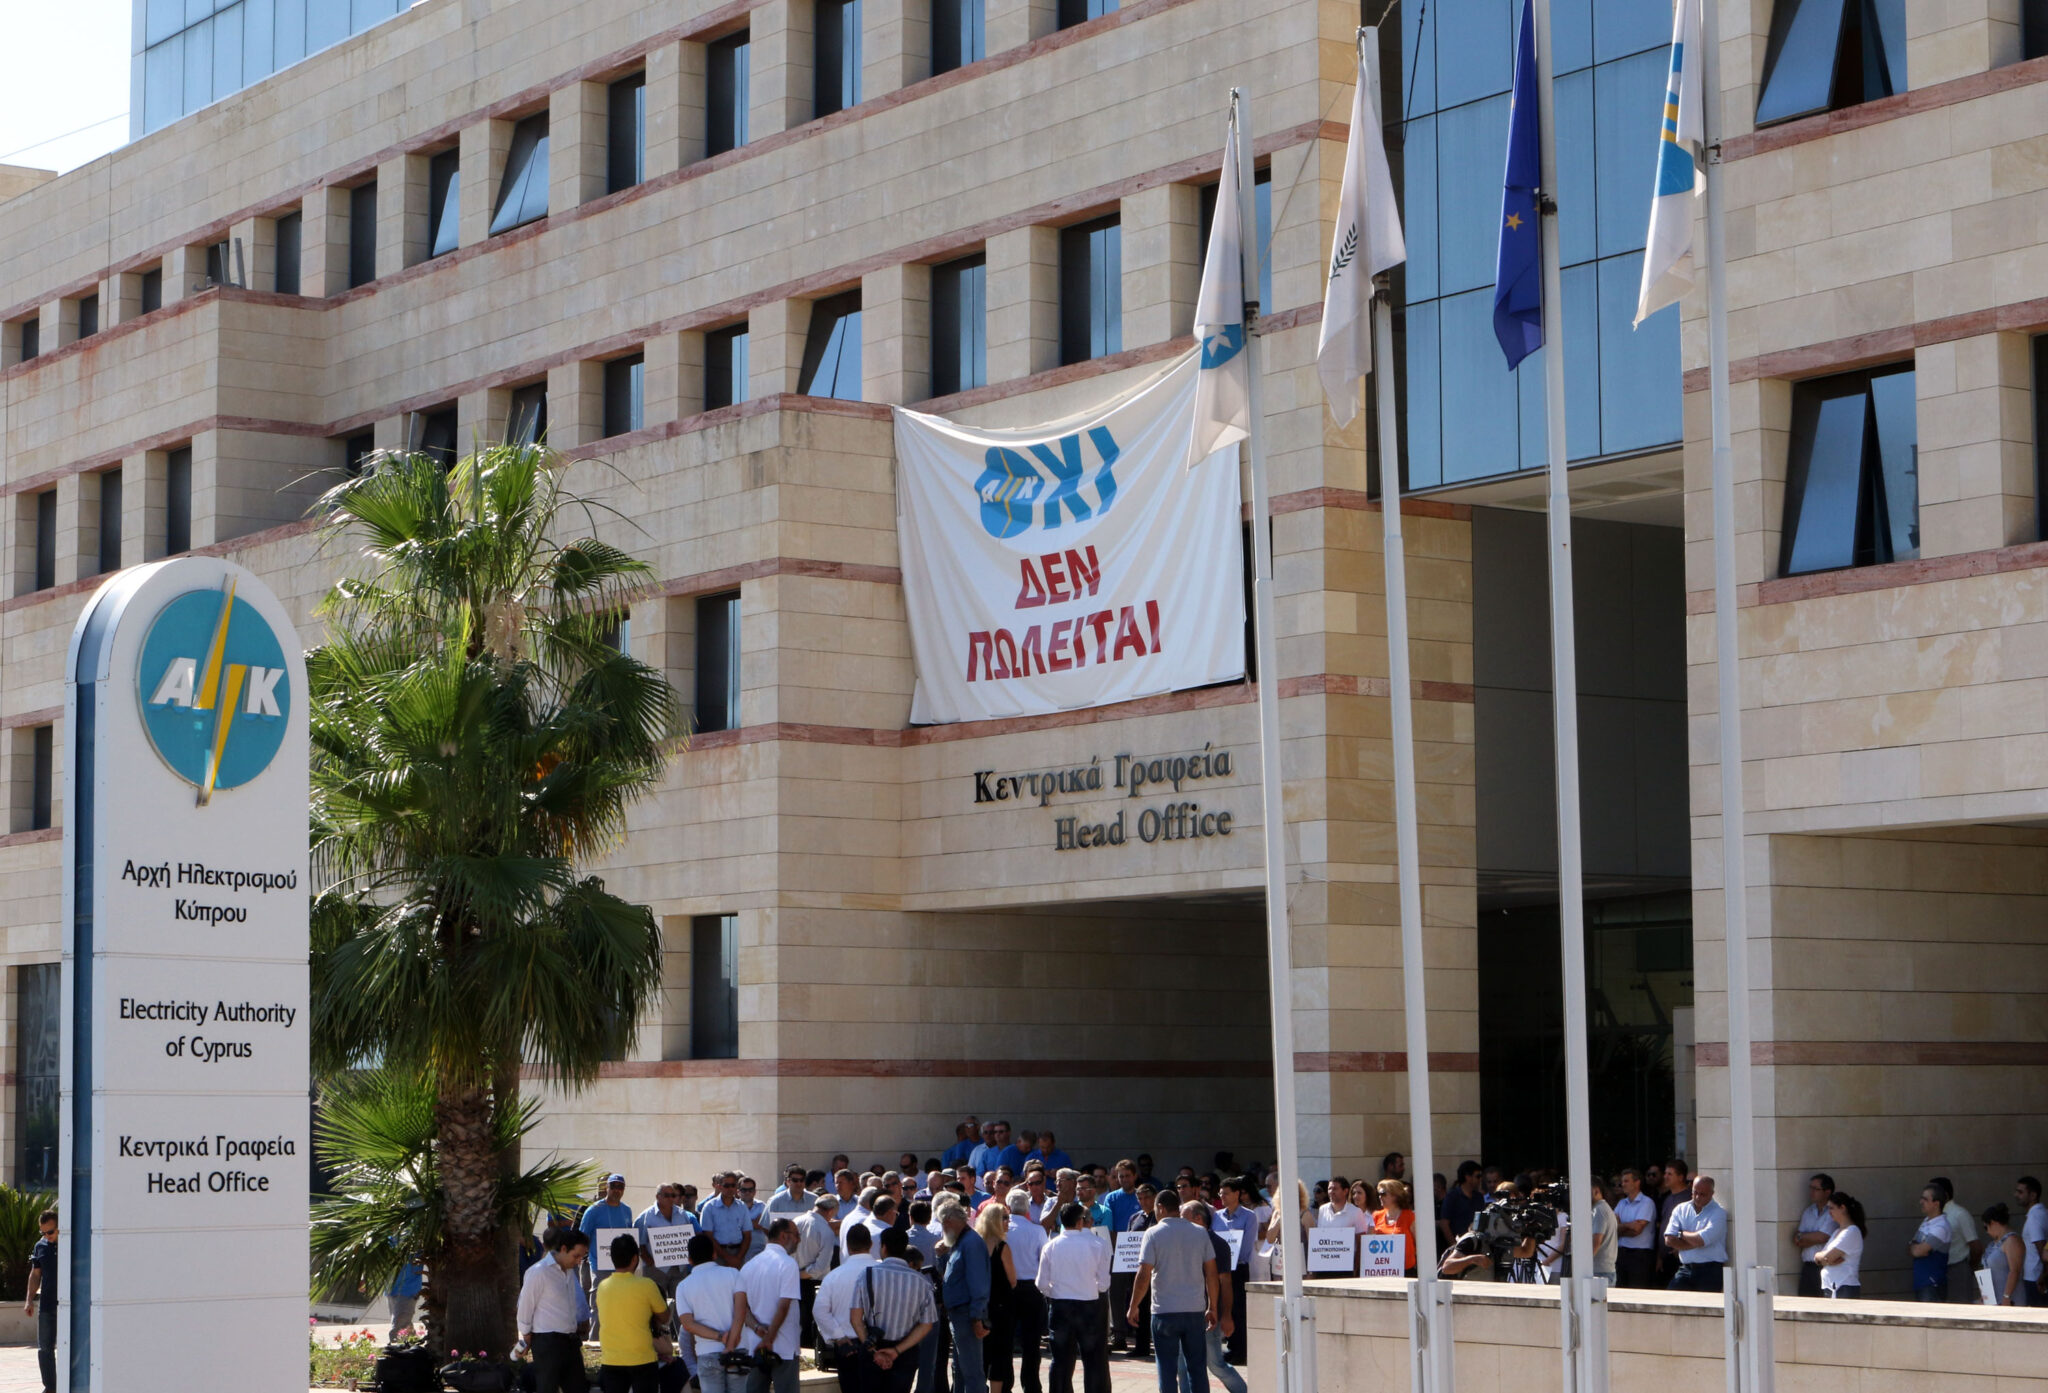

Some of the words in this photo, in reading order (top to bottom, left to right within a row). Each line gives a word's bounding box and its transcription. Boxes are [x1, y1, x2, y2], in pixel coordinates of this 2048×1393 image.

[1014, 544, 1102, 610] ΔΕΝ
[966, 600, 1162, 683] ΠΩΛΕΙΤΑΙ
[973, 755, 1102, 807] Κεντρικά
[1113, 741, 1232, 798] Γραφεία
[1054, 810, 1127, 851] Head
[1138, 802, 1232, 844] Office
[121, 859, 171, 888] Αρχή
[177, 862, 298, 894] Ηλεκτρισμού
[174, 898, 247, 927] Κύπρου
[119, 998, 209, 1027] Electricity
[213, 1001, 297, 1028] Authority
[165, 1036, 187, 1058] of
[190, 1037, 253, 1063] Cyprus
[119, 1135, 209, 1162] Κεντρικά
[215, 1134, 296, 1161] Γραφεία
[147, 1172, 201, 1194] Head
[208, 1171, 270, 1193] Office
[1368, 1240, 1394, 1254] ΟΧΙ
[1374, 1257, 1390, 1265] ΔΕΝ
[1364, 1268, 1400, 1277] ΠΩΛΕΙΤΑΙ
